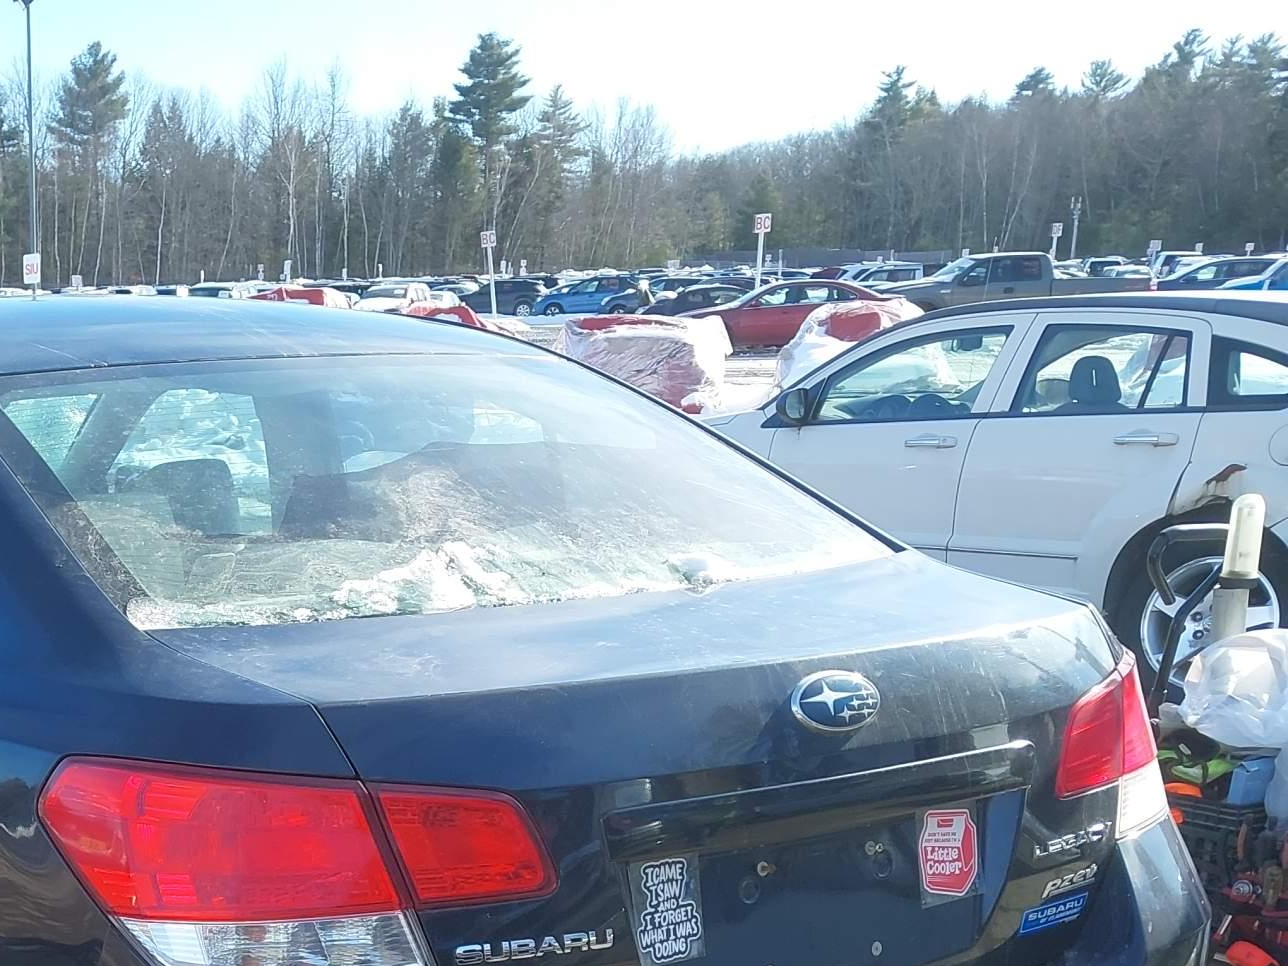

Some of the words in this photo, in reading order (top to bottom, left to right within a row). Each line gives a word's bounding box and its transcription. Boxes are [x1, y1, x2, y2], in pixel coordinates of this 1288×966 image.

[756, 216, 770, 230] BC
[481, 232, 496, 246] BC
[926, 847, 959, 861] Little
[653, 864, 683, 884] CAME
[926, 860, 962, 875] Cooler
[657, 880, 681, 902] SAW
[657, 898, 678, 912] AND
[1028, 898, 1084, 921] SUBARU
[653, 906, 693, 927] FORGET
[640, 926, 668, 948] WHAT
[676, 918, 698, 938] WAS
[455, 928, 614, 966] SUBARU
[654, 938, 687, 958] DOING
